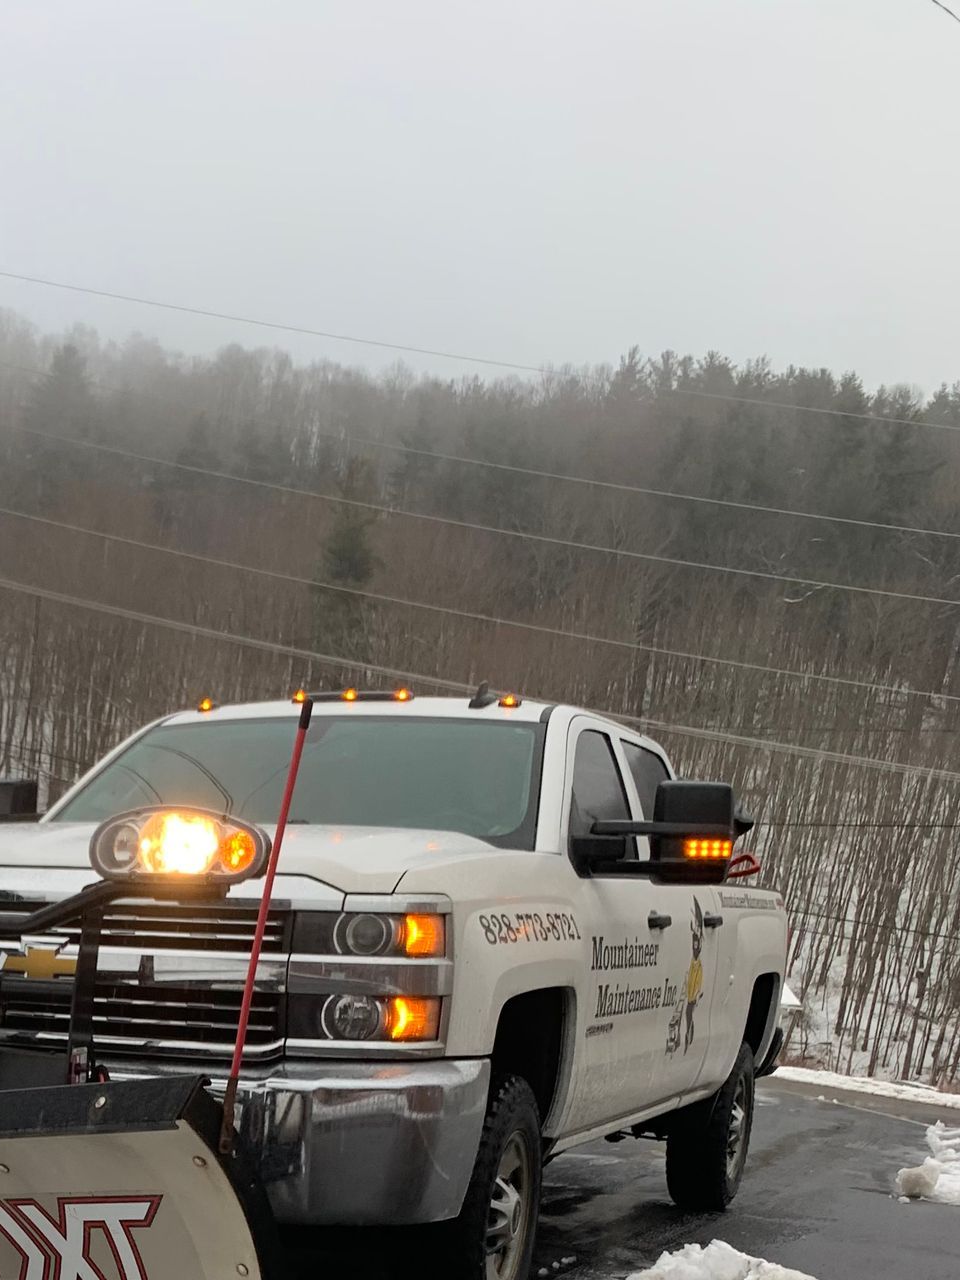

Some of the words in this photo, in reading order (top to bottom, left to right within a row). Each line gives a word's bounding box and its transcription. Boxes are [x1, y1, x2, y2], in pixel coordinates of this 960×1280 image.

[479, 913, 581, 945] 828-773-8721
[591, 936, 659, 971] Mountaineer
[594, 983, 662, 1018] Maintenance
